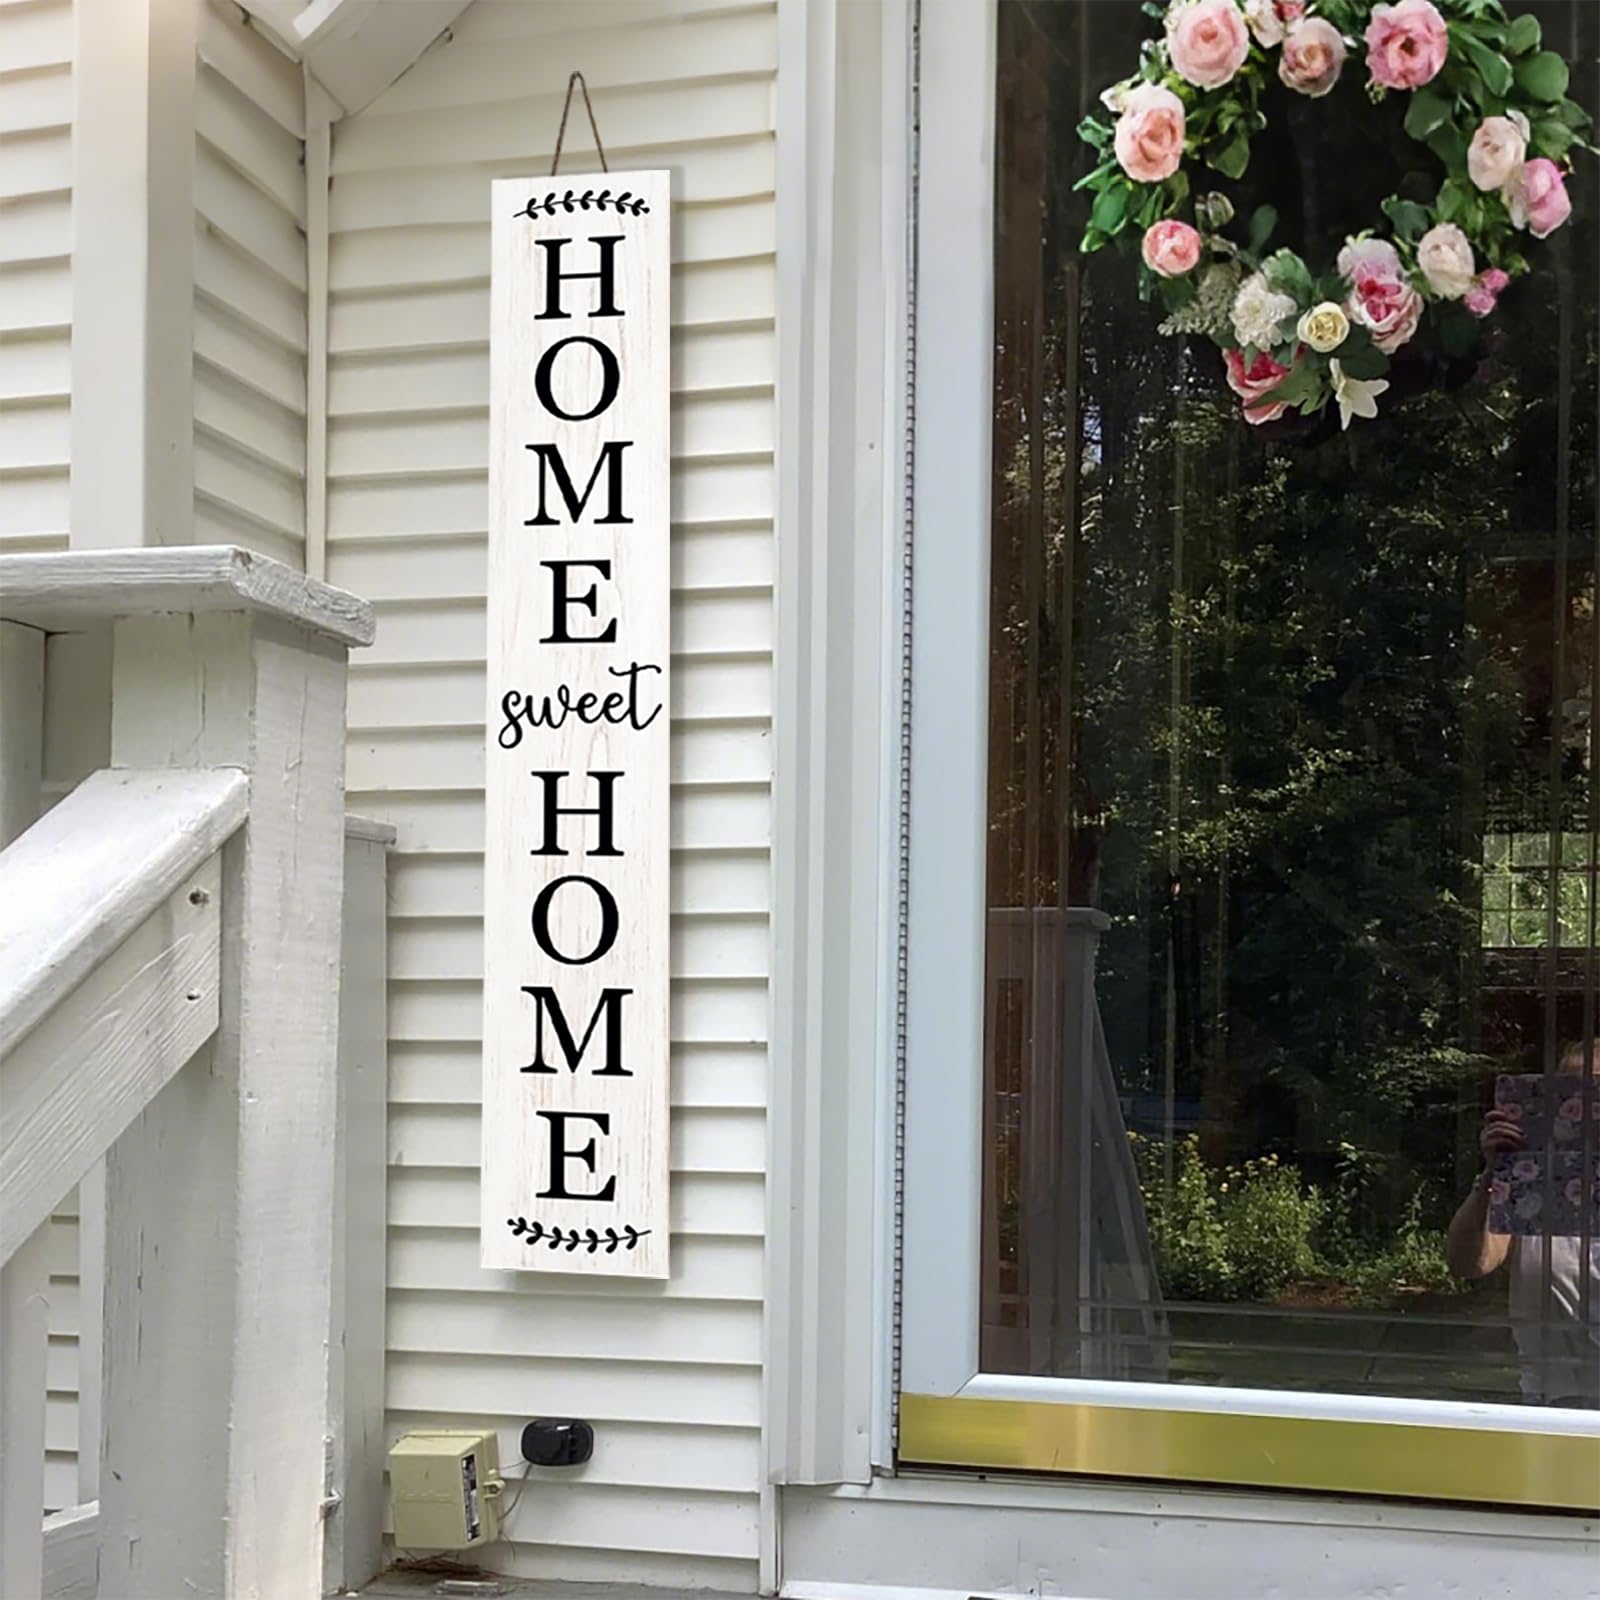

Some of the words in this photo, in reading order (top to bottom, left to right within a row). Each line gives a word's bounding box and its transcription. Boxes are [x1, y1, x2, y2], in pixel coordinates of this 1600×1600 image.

[523, 235, 634, 644] HOME
[498, 661, 662, 749] sweet
[520, 771, 634, 1202] HOME
